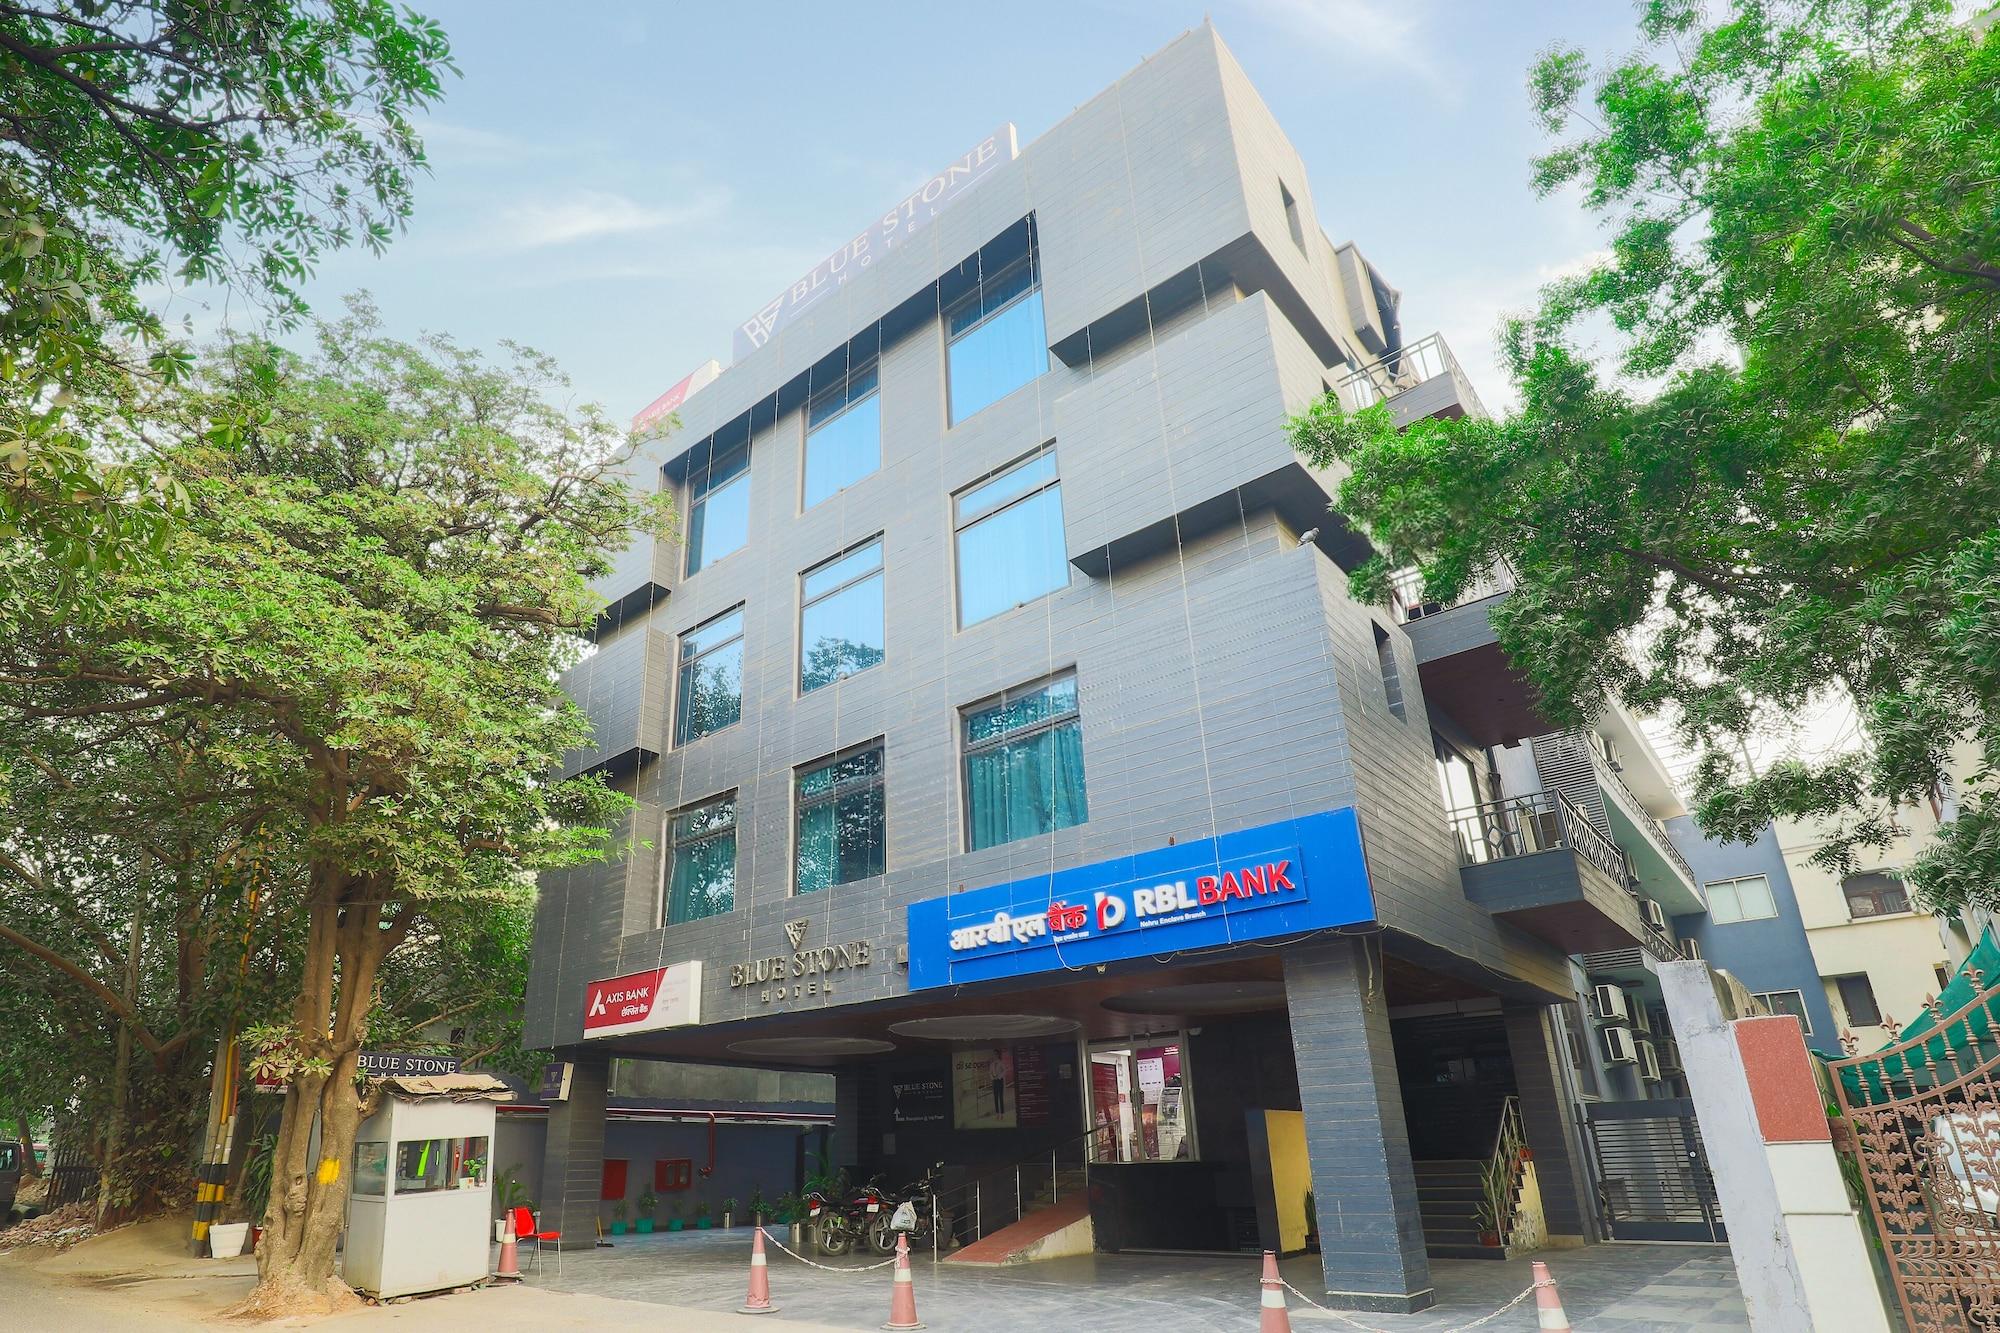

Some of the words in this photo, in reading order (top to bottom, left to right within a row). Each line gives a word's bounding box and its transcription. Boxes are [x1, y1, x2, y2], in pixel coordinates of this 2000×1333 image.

[790, 232, 870, 304] BLUE
[882, 136, 998, 235] STONE
[837, 207, 939, 286] HOTEL
[729, 956, 787, 987] BLUE
[791, 939, 872, 977] STONE
[605, 991, 624, 1004] AXIS
[625, 986, 649, 1001] BANK
[760, 979, 832, 1002] HOTEL
[357, 1055, 400, 1070] BLUE
[405, 1058, 456, 1073] STONE
